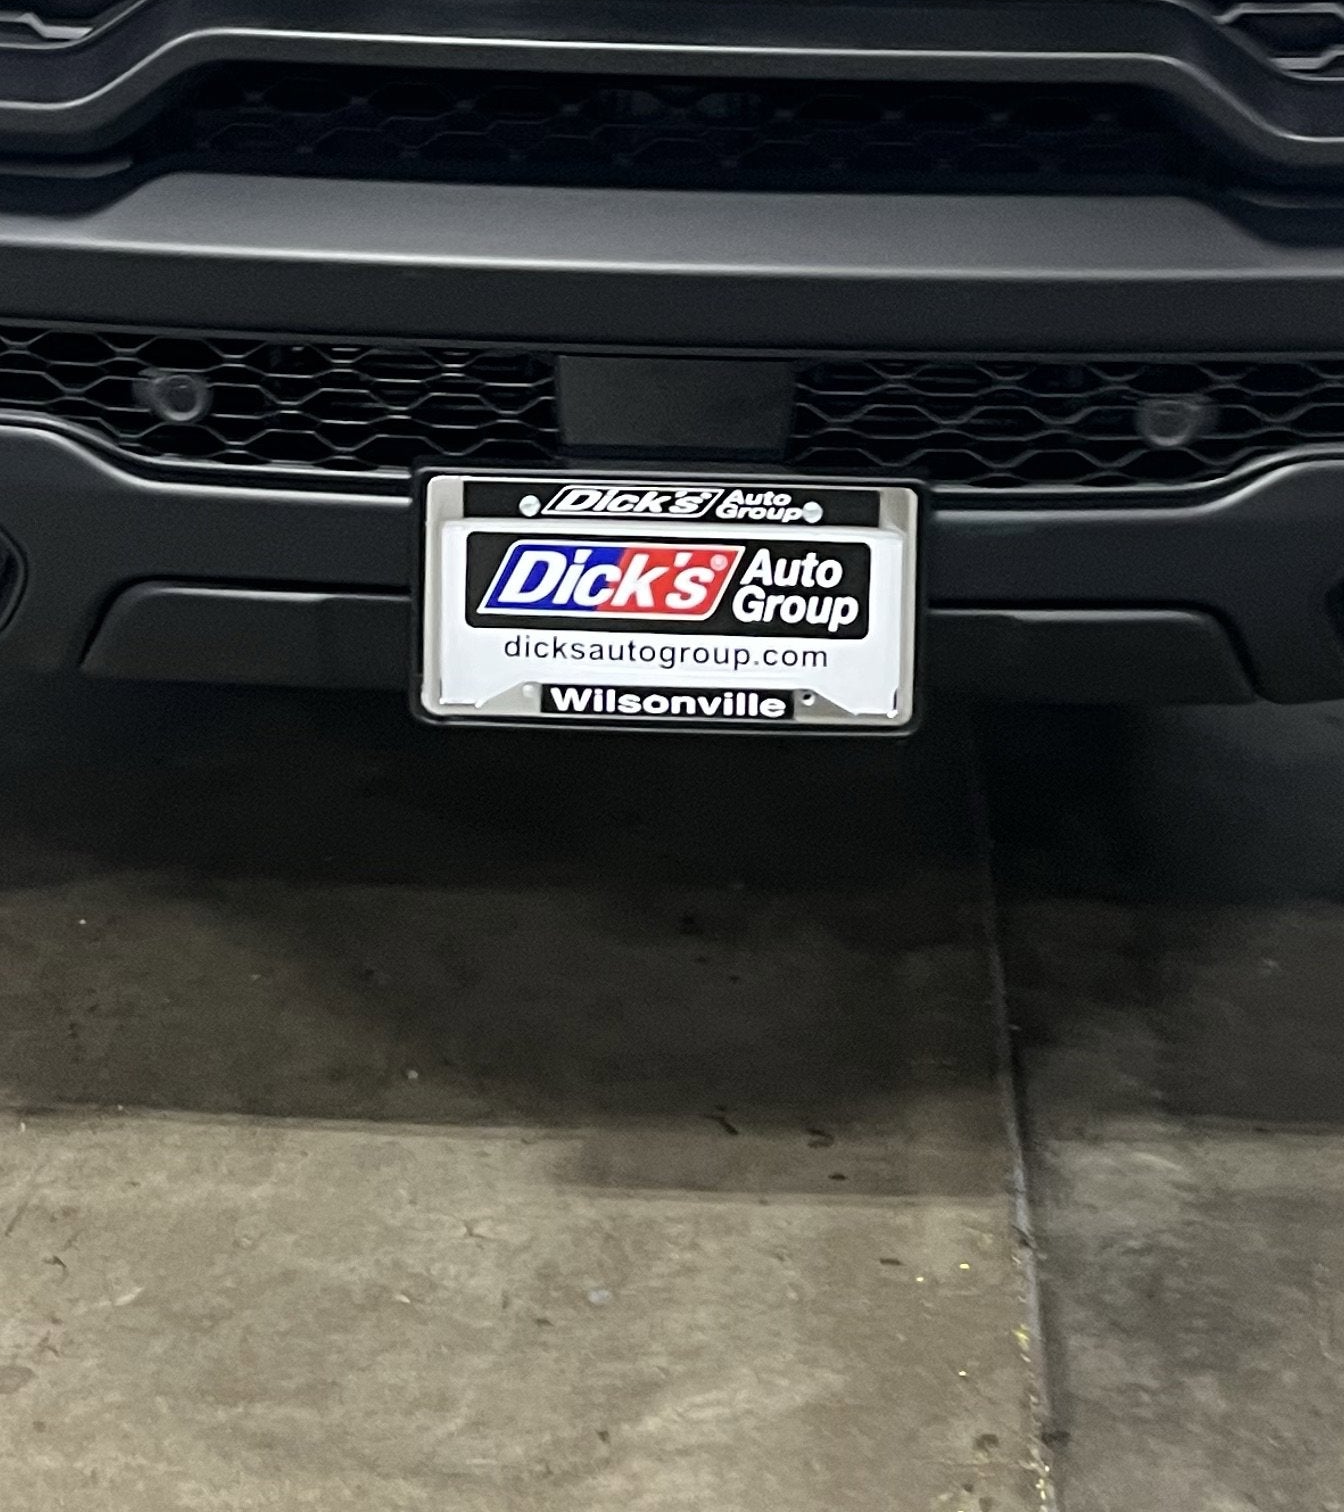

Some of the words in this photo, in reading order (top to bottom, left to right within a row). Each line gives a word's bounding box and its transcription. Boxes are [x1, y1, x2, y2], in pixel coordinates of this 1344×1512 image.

[555, 488, 702, 514] Dick's
[716, 502, 804, 523] Group
[726, 489, 792, 506] Auto
[496, 548, 713, 609] Dick's
[740, 548, 843, 589] Auto
[732, 585, 859, 632] Group
[503, 635, 828, 669] dicksautogroup.com
[550, 687, 787, 719] Wilsonville
